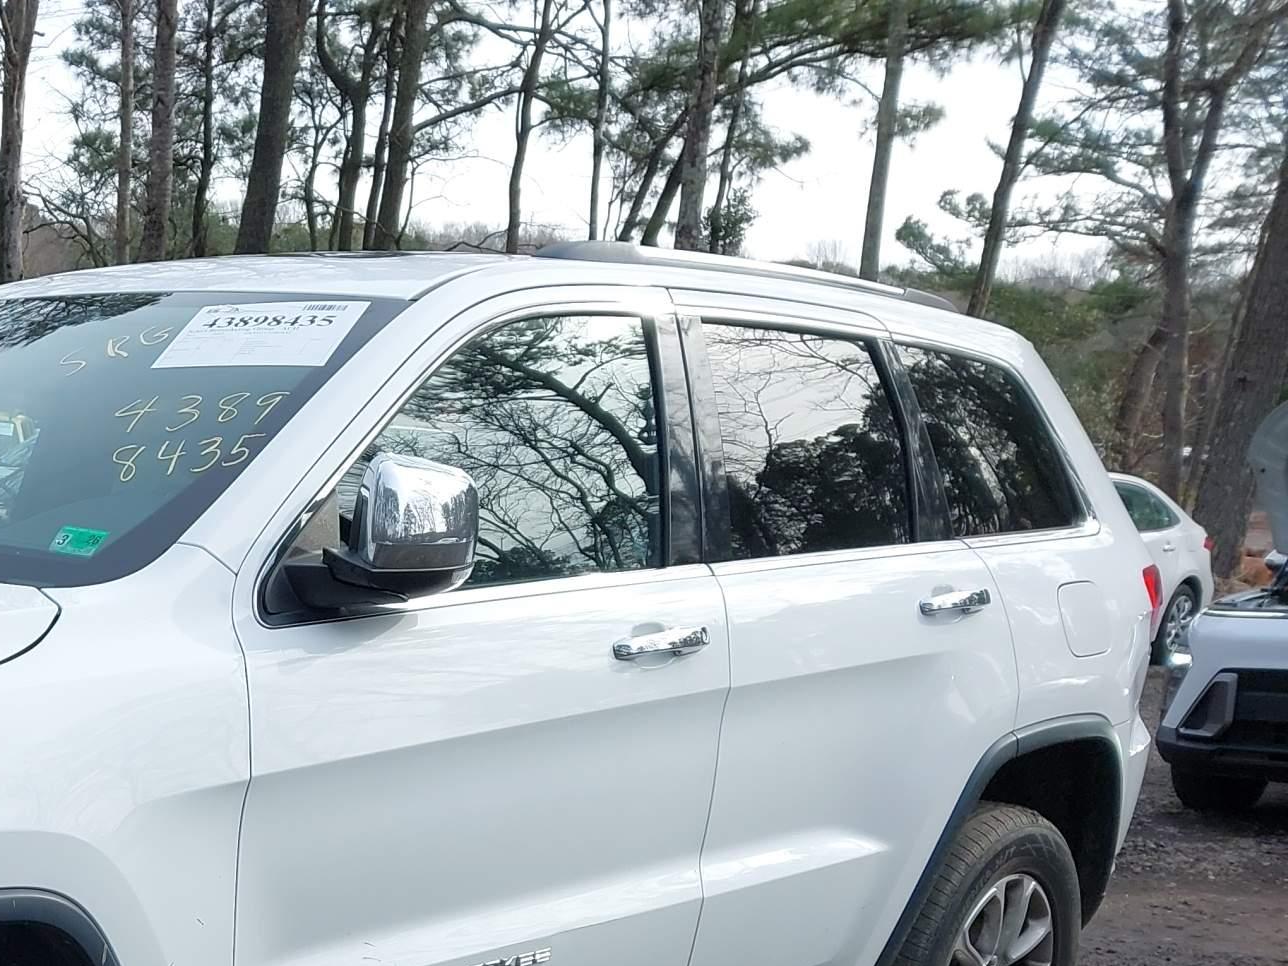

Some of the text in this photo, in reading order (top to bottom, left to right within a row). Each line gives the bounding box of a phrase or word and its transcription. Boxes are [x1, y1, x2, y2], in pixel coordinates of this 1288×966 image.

[202, 314, 337, 329] 43898435
[114, 391, 290, 433] 4389
[112, 433, 267, 482] 8435
